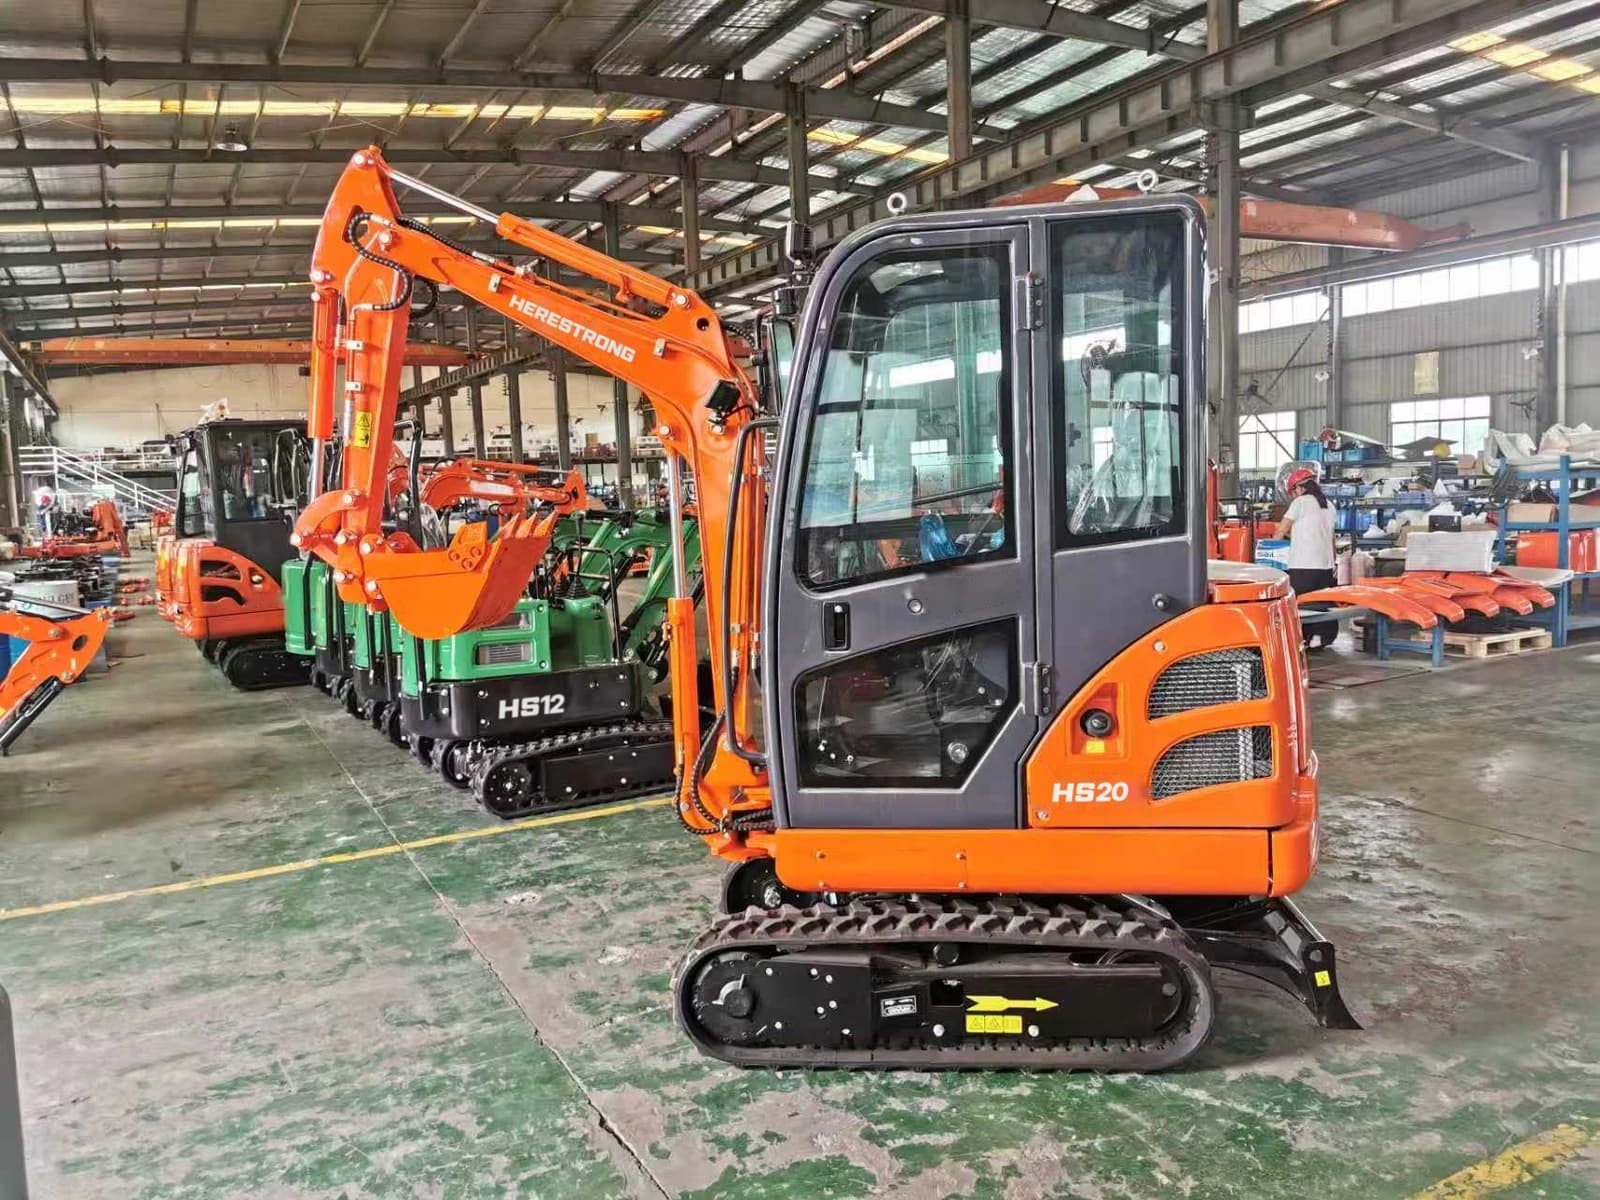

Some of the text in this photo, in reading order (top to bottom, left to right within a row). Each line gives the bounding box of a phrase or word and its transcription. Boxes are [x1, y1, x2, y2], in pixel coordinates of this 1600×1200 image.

[508, 294, 636, 363] HERESTRONG
[498, 693, 565, 720] HS12
[1051, 781, 1129, 803] HS20
